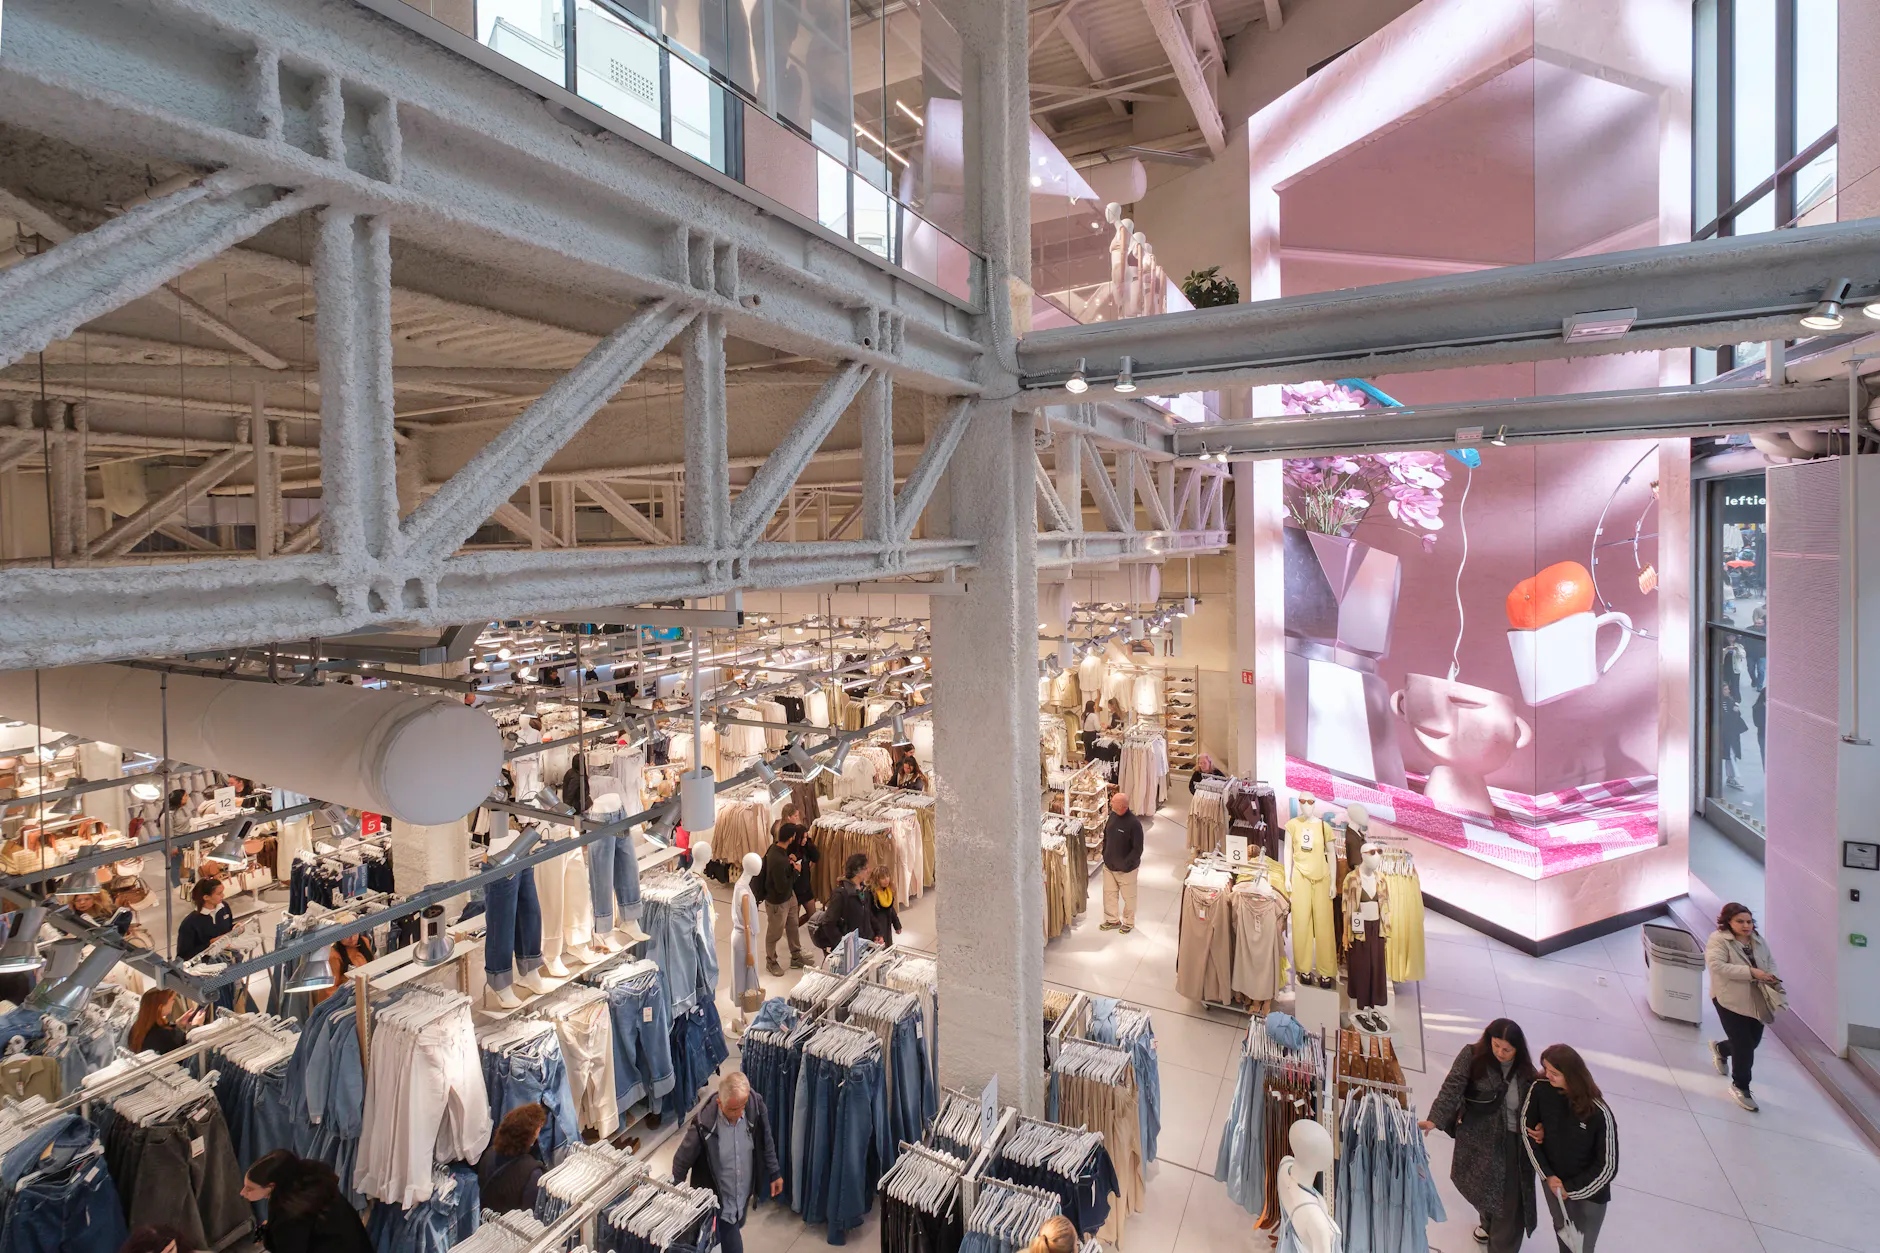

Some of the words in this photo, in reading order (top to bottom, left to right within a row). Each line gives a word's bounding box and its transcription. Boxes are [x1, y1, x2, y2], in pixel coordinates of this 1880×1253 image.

[219, 797, 231, 808] 12
[367, 820, 377, 831] 5
[1303, 834, 1310, 843] 9
[1233, 849, 1241, 861] 8
[1354, 918, 1361, 928] 9
[986, 1106, 993, 1129] 9
